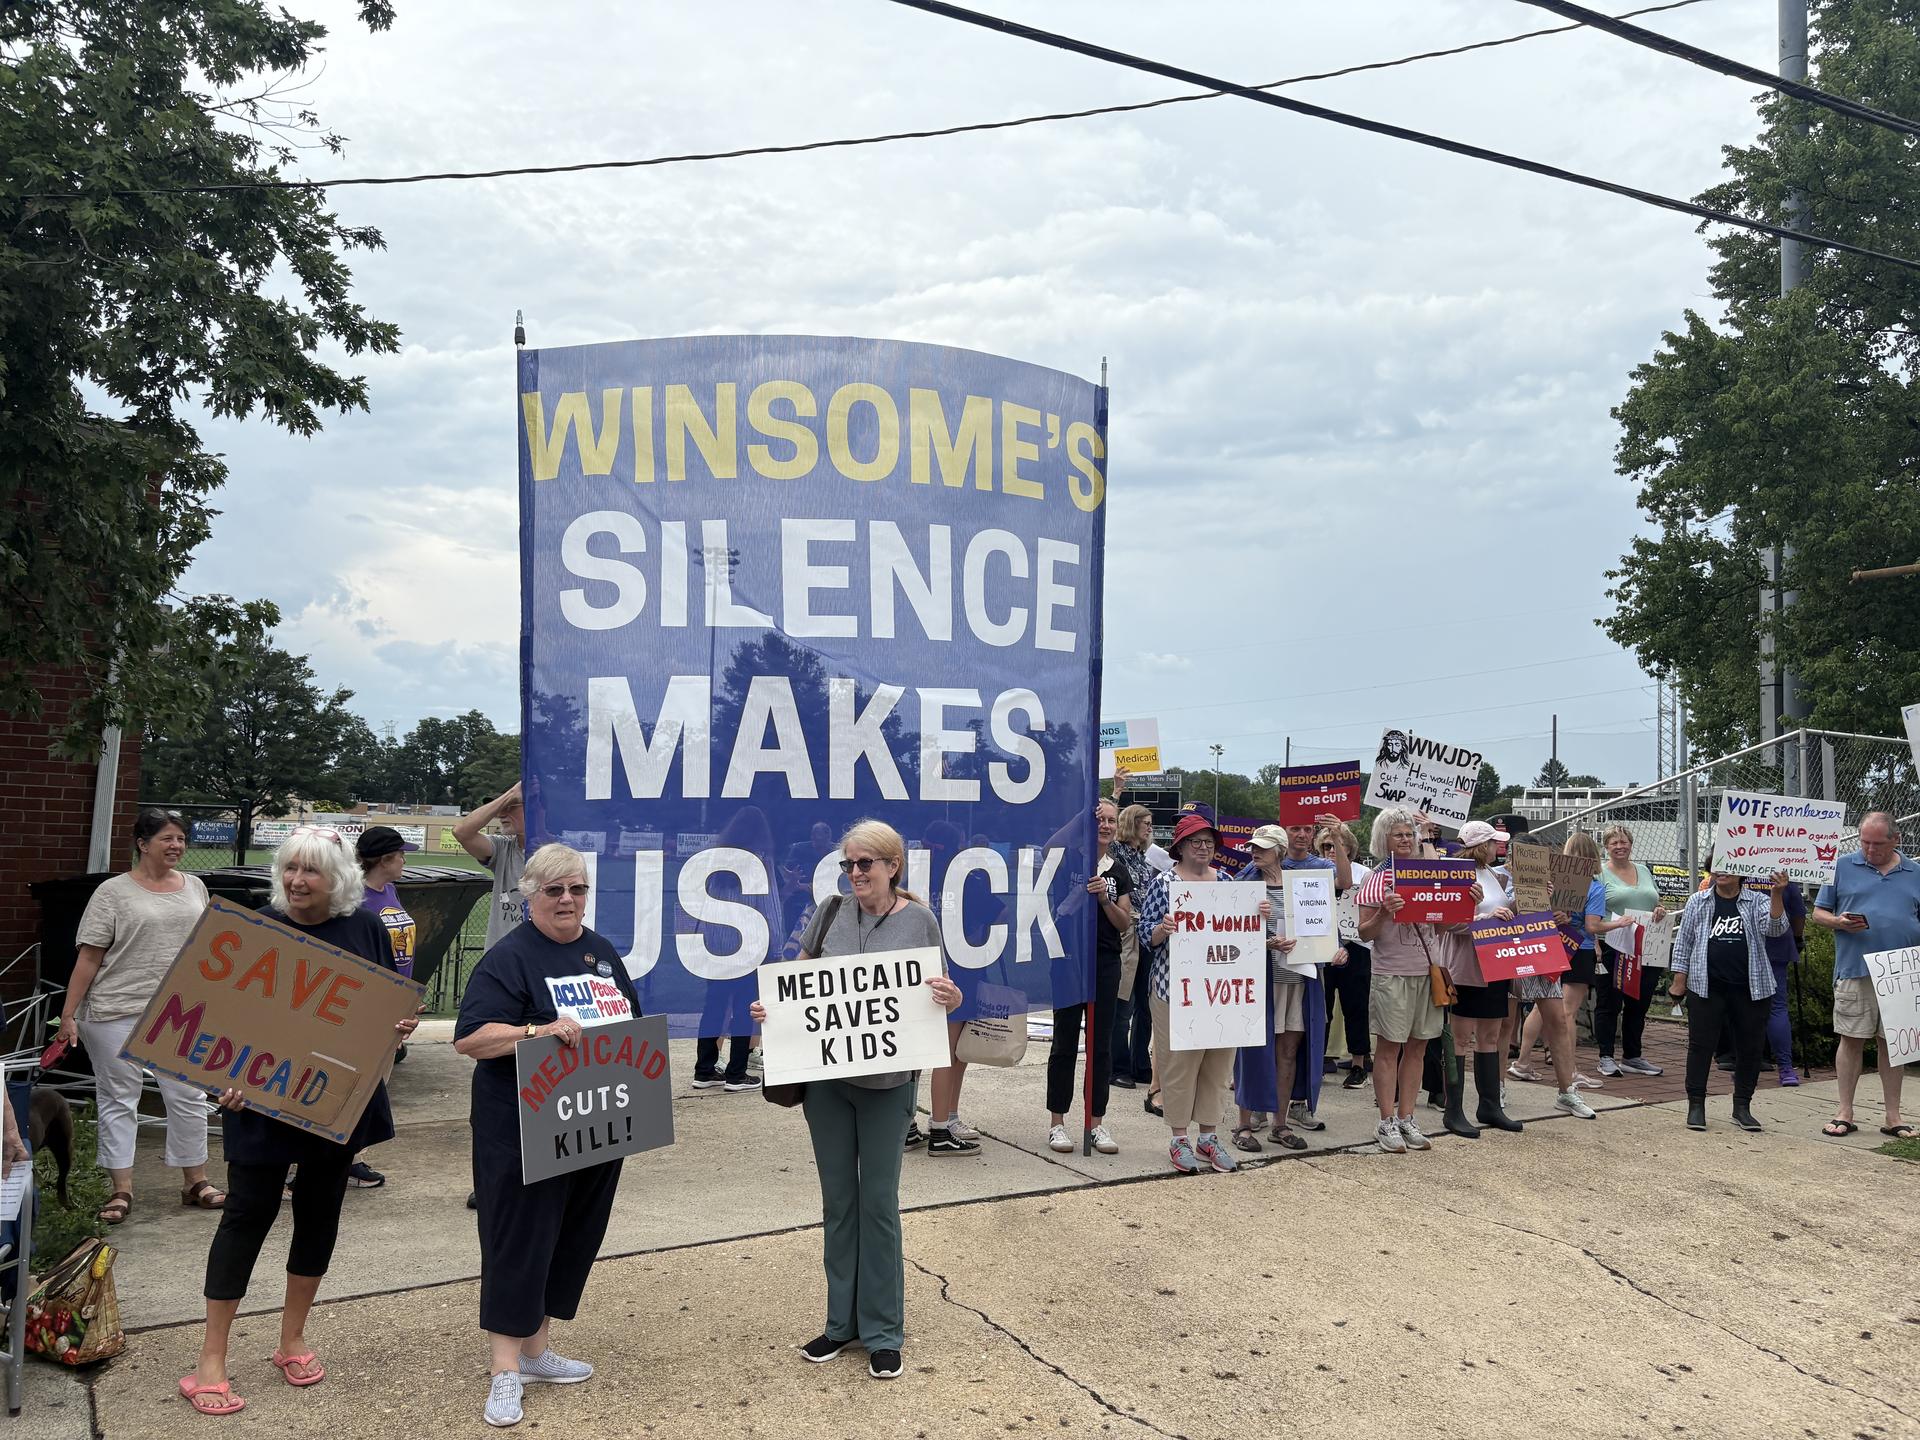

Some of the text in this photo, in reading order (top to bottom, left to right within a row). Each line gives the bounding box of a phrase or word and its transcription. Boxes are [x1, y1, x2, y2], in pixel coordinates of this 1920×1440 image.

[522, 380, 1104, 512] WINSOME'S
[560, 510, 1079, 652] SILENCE
[586, 676, 1046, 804] MAKES
[1116, 752, 1157, 763] Medicaid
[1408, 736, 1482, 770] WWJD?
[1281, 769, 1360, 786] MEDICAID CUTS
[1380, 772, 1458, 798] cut funding for
[1409, 763, 1476, 793] He would NOT
[1297, 793, 1347, 805] JOB CUTS
[1375, 782, 1466, 820] SNAP and MEDICAID
[1727, 796, 1771, 818] VOTE
[1219, 825, 1255, 834] MEDICA
[1727, 823, 1839, 842] NO TRUMP agenda
[1214, 852, 1238, 867] CAID
[1516, 845, 1545, 860] PROTECT
[1727, 847, 1746, 860] NO
[1779, 857, 1808, 866] agenda
[1396, 870, 1476, 879] MEDICAID CUTS
[1549, 853, 1597, 877] EALTHCARE
[1725, 862, 1755, 874] HANDS
[1758, 865, 1776, 874] OFF
[812, 847, 1065, 969] CK
[1299, 899, 1327, 907] VIRGINIA
[1412, 892, 1461, 901] JOB CUTS
[1173, 911, 1261, 932] PRO-WOMAN
[1472, 920, 1556, 939] MEDICAID CUTS
[1207, 944, 1241, 962] AND
[1496, 943, 1547, 958] JOB CUTS
[1875, 948, 1920, 978] SEAR
[199, 931, 364, 1026] SAVE
[777, 960, 922, 1002] MEDICAID
[1876, 977, 1902, 997] CUT
[553, 981, 594, 1008] ACLU
[1180, 978, 1256, 1007] I VOTE
[576, 999, 630, 1020] Fairfax Power
[804, 996, 900, 1033] SAVES
[143, 991, 329, 1106] MEDICAID
[820, 1030, 898, 1066] KIDS
[520, 1034, 666, 1113] MEDICAID
[557, 1083, 630, 1121] CUTS
[554, 1116, 632, 1159] KILL!
